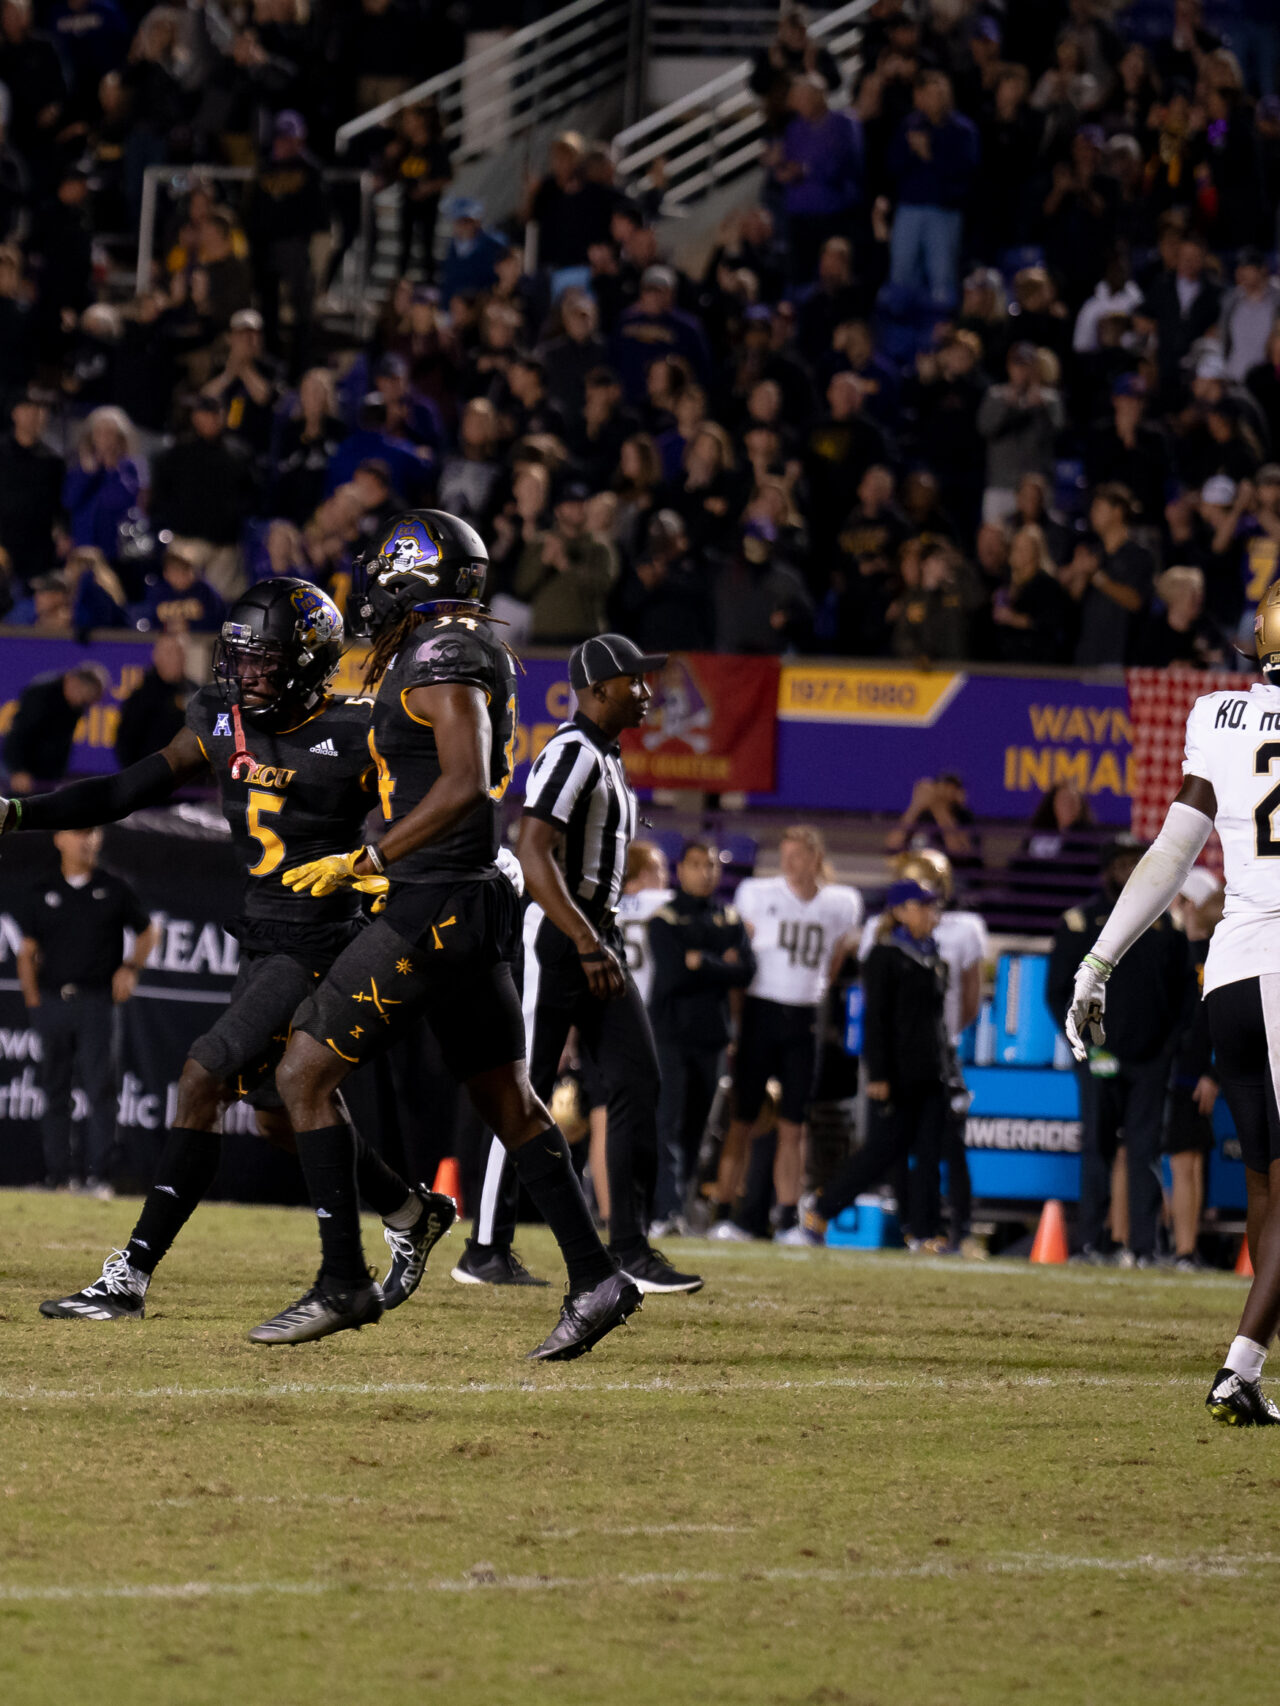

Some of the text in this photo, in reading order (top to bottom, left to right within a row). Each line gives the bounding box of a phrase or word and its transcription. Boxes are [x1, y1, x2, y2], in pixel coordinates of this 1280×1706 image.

[397, 526, 421, 536] ECU
[300, 598, 317, 611] ECU
[1214, 698, 1248, 730] KO.
[309, 746, 339, 757] adidas
[244, 763, 297, 788] ECU
[247, 788, 287, 878] 5
[778, 918, 824, 969] 40
